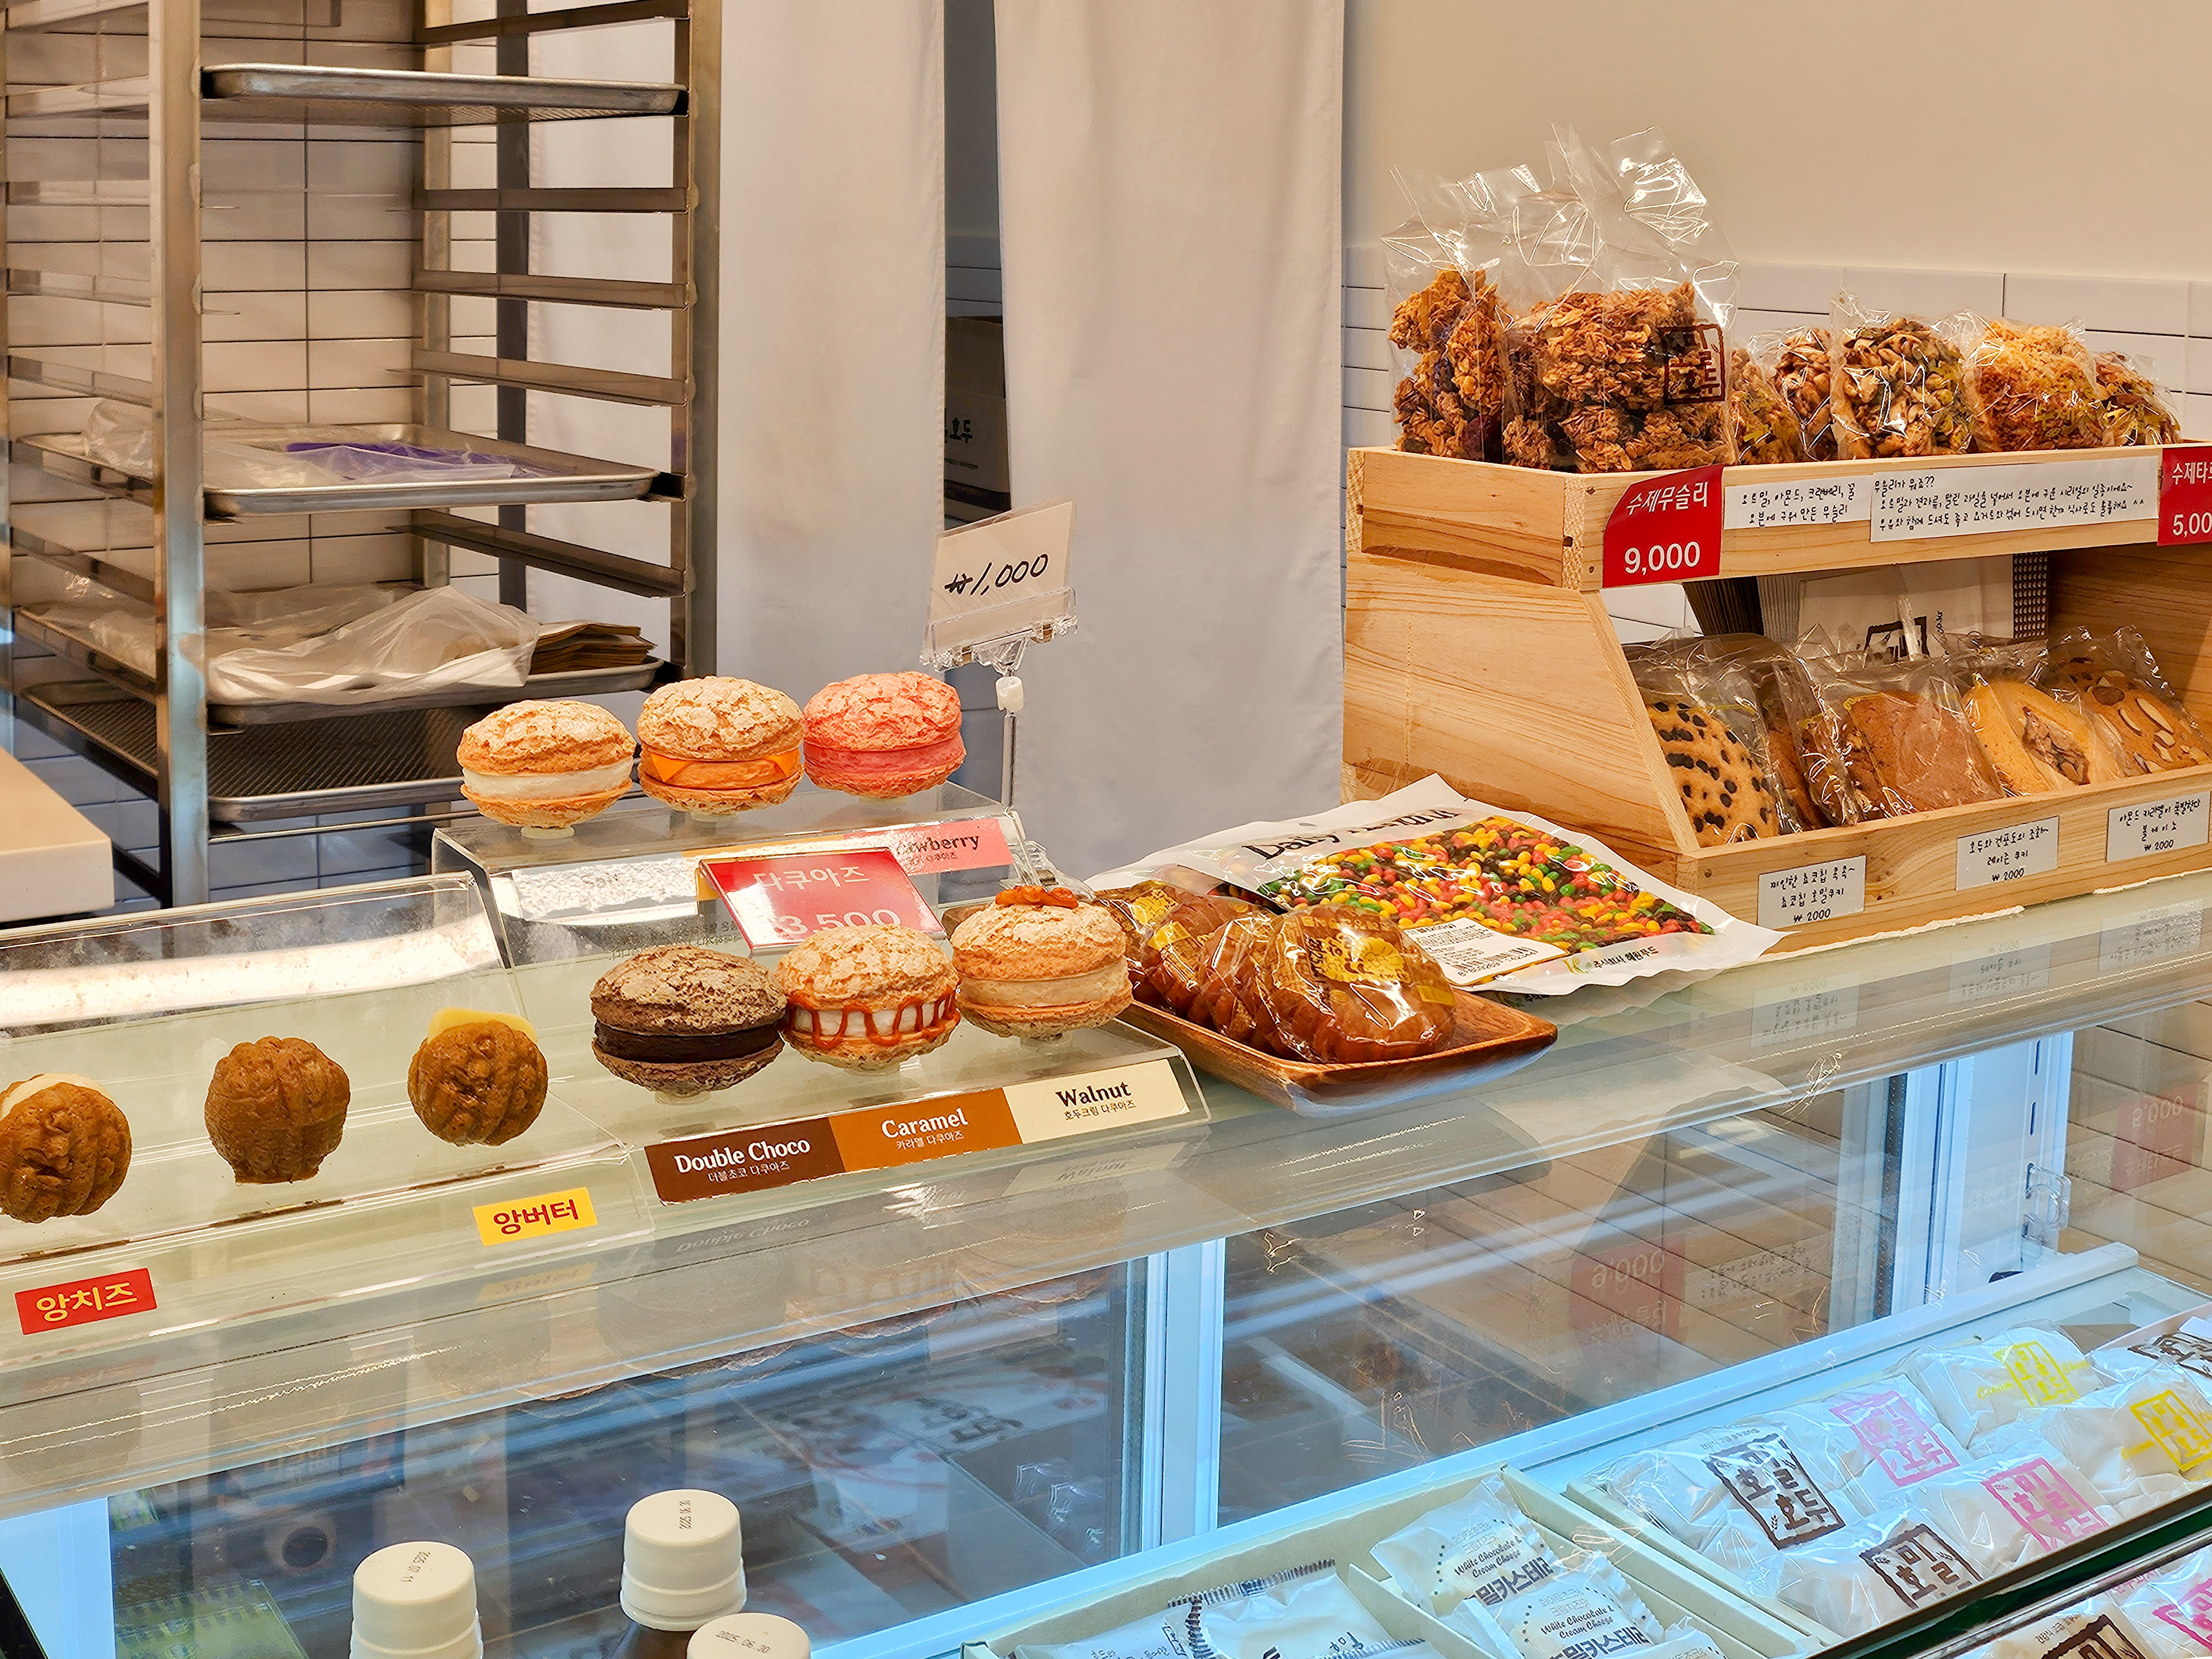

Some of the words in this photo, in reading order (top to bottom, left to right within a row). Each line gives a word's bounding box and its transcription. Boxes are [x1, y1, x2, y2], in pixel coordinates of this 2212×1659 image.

[1626, 480, 1709, 516] 수제무슬리
[1741, 491, 1770, 508] 오트밀,
[1775, 489, 1803, 506] 아몬드,
[1848, 483, 1855, 500] 꿀
[2018, 488, 2039, 502] 오븐에
[1749, 511, 1775, 526] 오븐에
[1781, 511, 1797, 522] 구워
[1800, 506, 1816, 521] 만든
[1823, 504, 1847, 523] 무슬리
[1624, 541, 1701, 576] 9,000
[2119, 810, 2140, 826] 아몬드
[1969, 838, 1991, 854] 호두와
[2015, 851, 2028, 860] 쿠키
[2154, 839, 2174, 851] 2000
[753, 866, 870, 891] 다쿠아즈
[1803, 869, 1827, 885] 초코칩
[2004, 868, 2025, 881] 2000
[1781, 892, 1806, 908] 초코칩
[1807, 909, 1831, 921] 2000
[1055, 1081, 1131, 1109] Walnut
[1063, 1106, 1099, 1121] 호두크림
[1100, 1099, 1136, 1114] 다쿠아즈
[881, 1107, 968, 1139] Caramel
[895, 1135, 924, 1150] 카라멜
[926, 1130, 964, 1146] 다쿠아즈
[674, 1146, 745, 1173] Double
[749, 1138, 811, 1164] Choco
[749, 1160, 790, 1176] 다쿠아즈
[492, 1198, 580, 1234] 앙버터
[35, 1282, 138, 1322] 앙치즈
[1454, 1558, 1479, 1575] White
[1478, 1540, 1516, 1562] Chocolate
[1472, 1563, 1498, 1578] Cream
[1495, 1549, 1521, 1566] Cheese
[1540, 1619, 1567, 1635] White
[1566, 1608, 1607, 1626] Chocolate
[1559, 1627, 1588, 1639] Cream
[1586, 1616, 1614, 1631] Cheese
